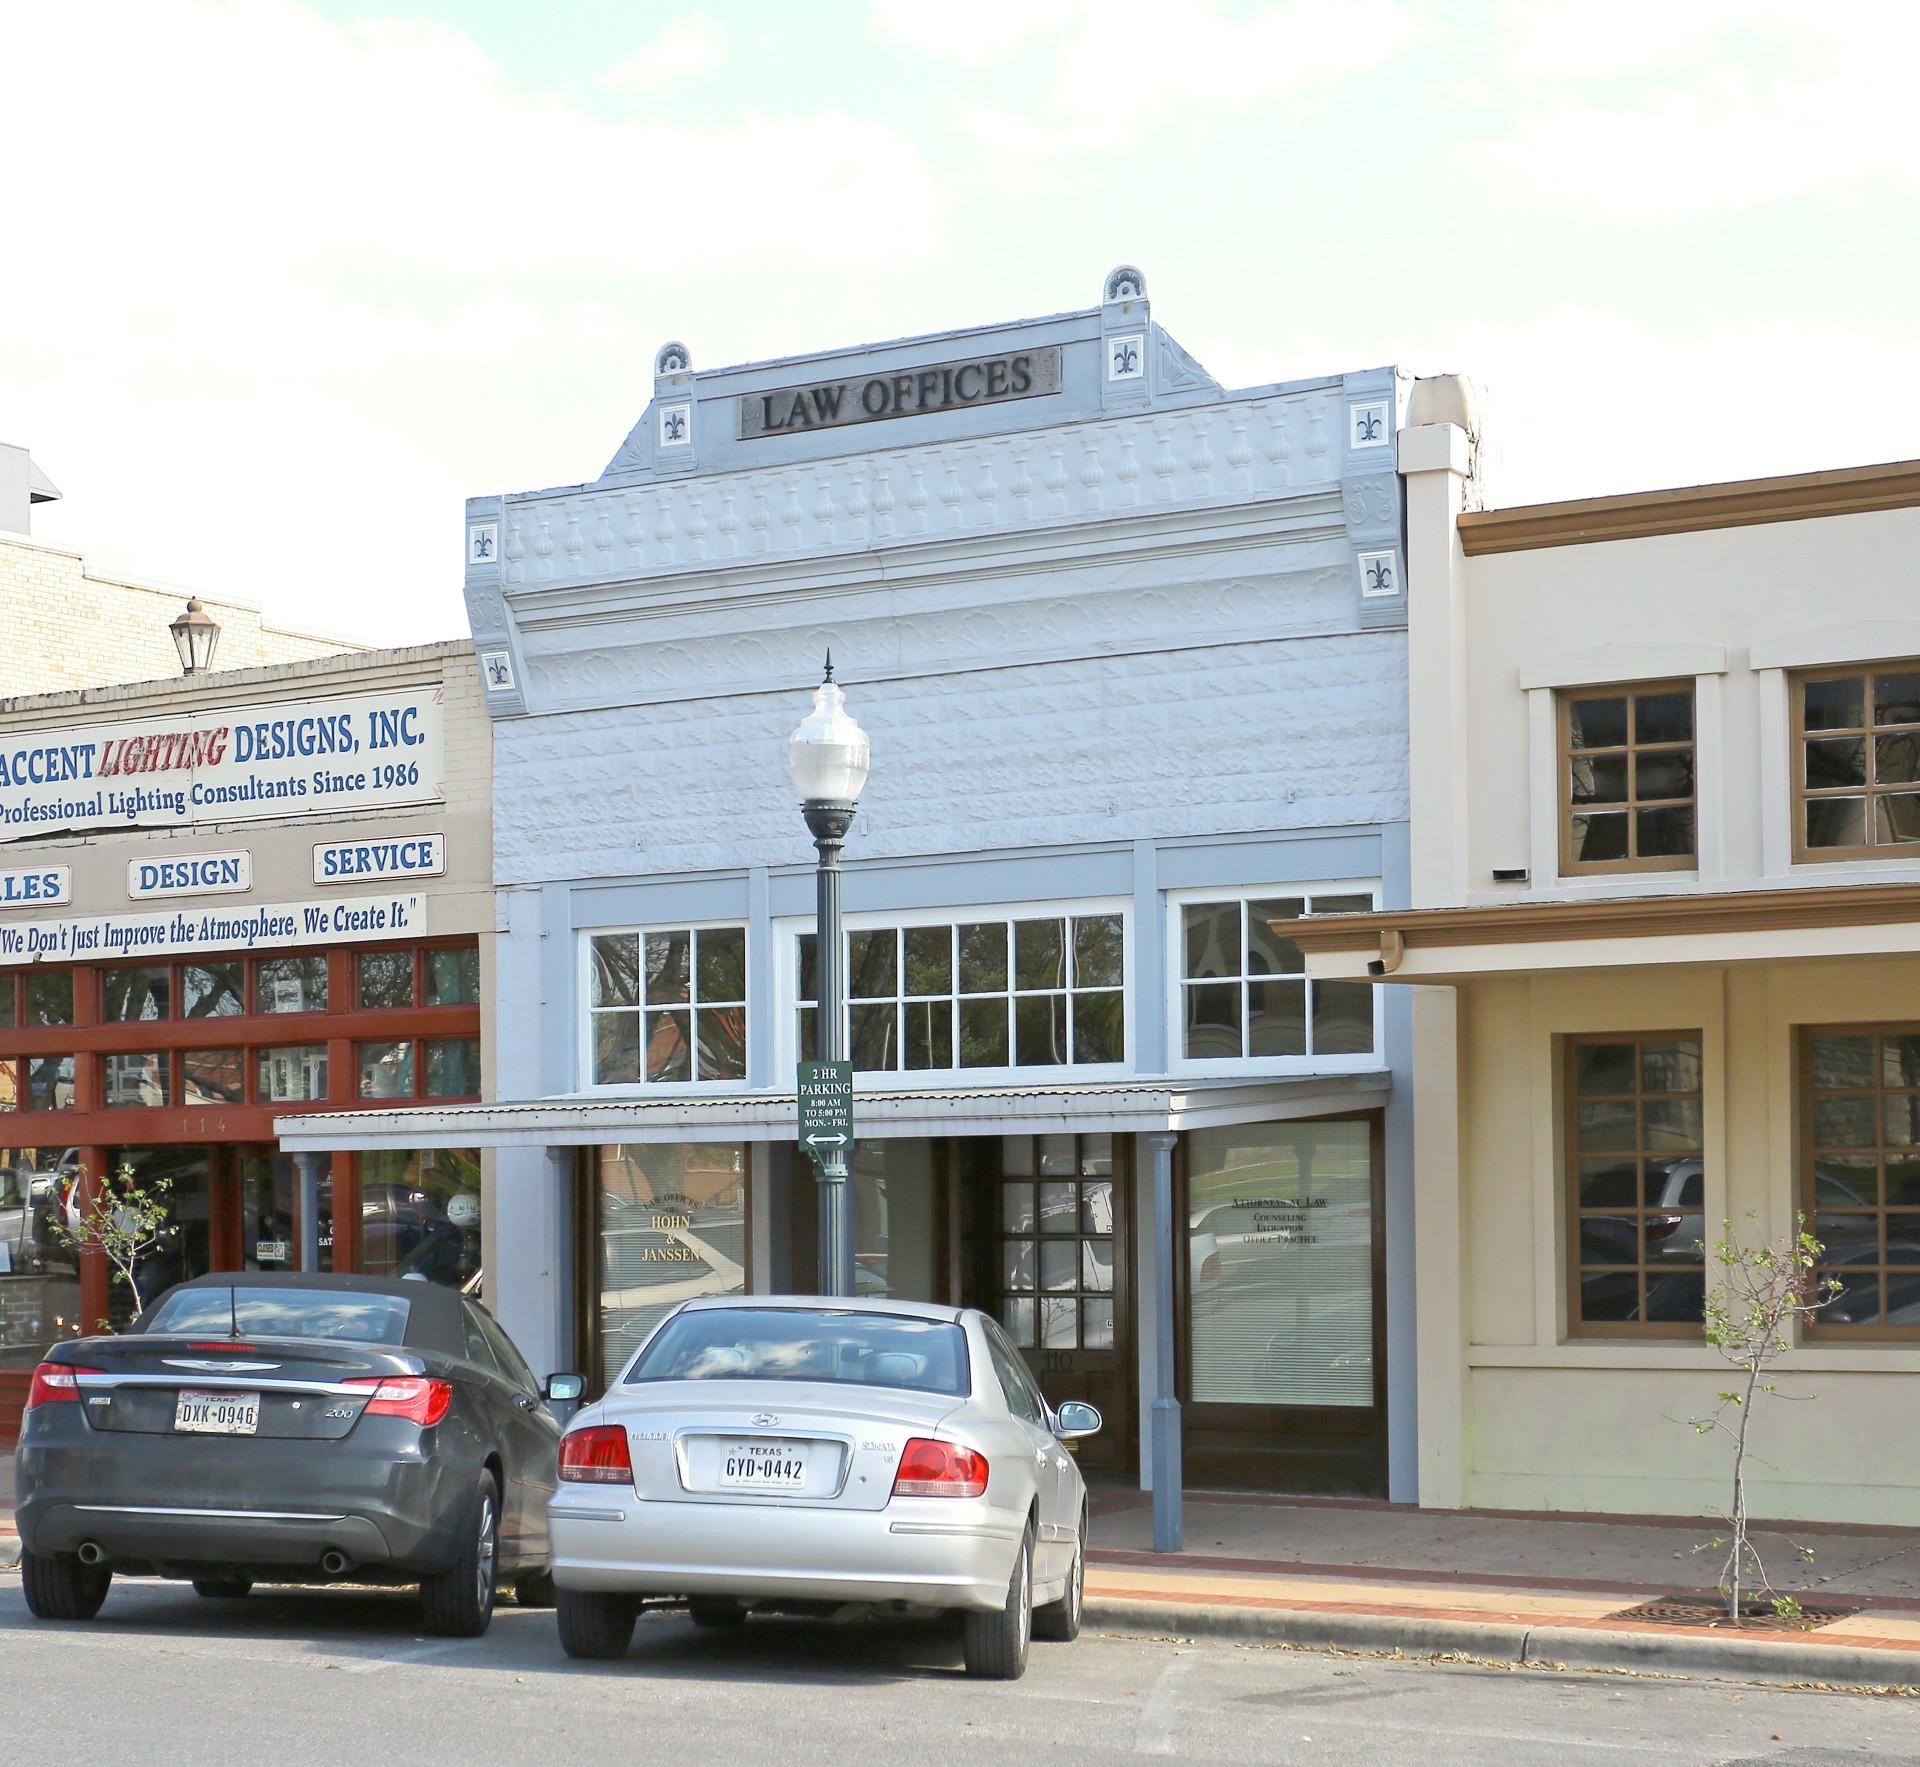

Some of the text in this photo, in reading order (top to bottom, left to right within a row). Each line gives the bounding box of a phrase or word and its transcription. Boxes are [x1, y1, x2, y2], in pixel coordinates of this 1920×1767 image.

[760, 356, 1032, 431] LAW OFFICES
[0, 707, 425, 787] ACCENT LIGHTING DESIGNS, INC.
[108, 787, 186, 819] Lighting
[191, 775, 307, 805] Consultants
[313, 770, 366, 795] Since
[372, 760, 419, 790] 1986
[323, 841, 433, 876] SERVICE
[139, 858, 240, 890] DESIGN
[0, 873, 60, 901] LES
[27, 924, 68, 952] Don't
[70, 925, 100, 957] Just
[104, 922, 165, 954] Improve
[170, 913, 195, 943] the
[198, 907, 297, 947] Atmosphere,
[303, 907, 329, 934] We
[333, 905, 386, 932] Create
[390, 897, 416, 928] It."
[812, 1068, 838, 1080] 2 HR
[800, 1083, 851, 1095] PARKING
[810, 1098, 841, 1107] 8:00 AM
[805, 1108, 847, 1117] TO 5:00 PM
[182, 1117, 226, 1133] 114
[804, 1119, 826, 1127] MON.
[832, 1118, 848, 1127] FRI.
[651, 1215, 691, 1229] HOHN
[666, 1232, 676, 1245] &
[642, 1248, 701, 1261] JANSSEN
[324, 1408, 354, 1419] 200
[749, 1447, 782, 1456] TEXAS
